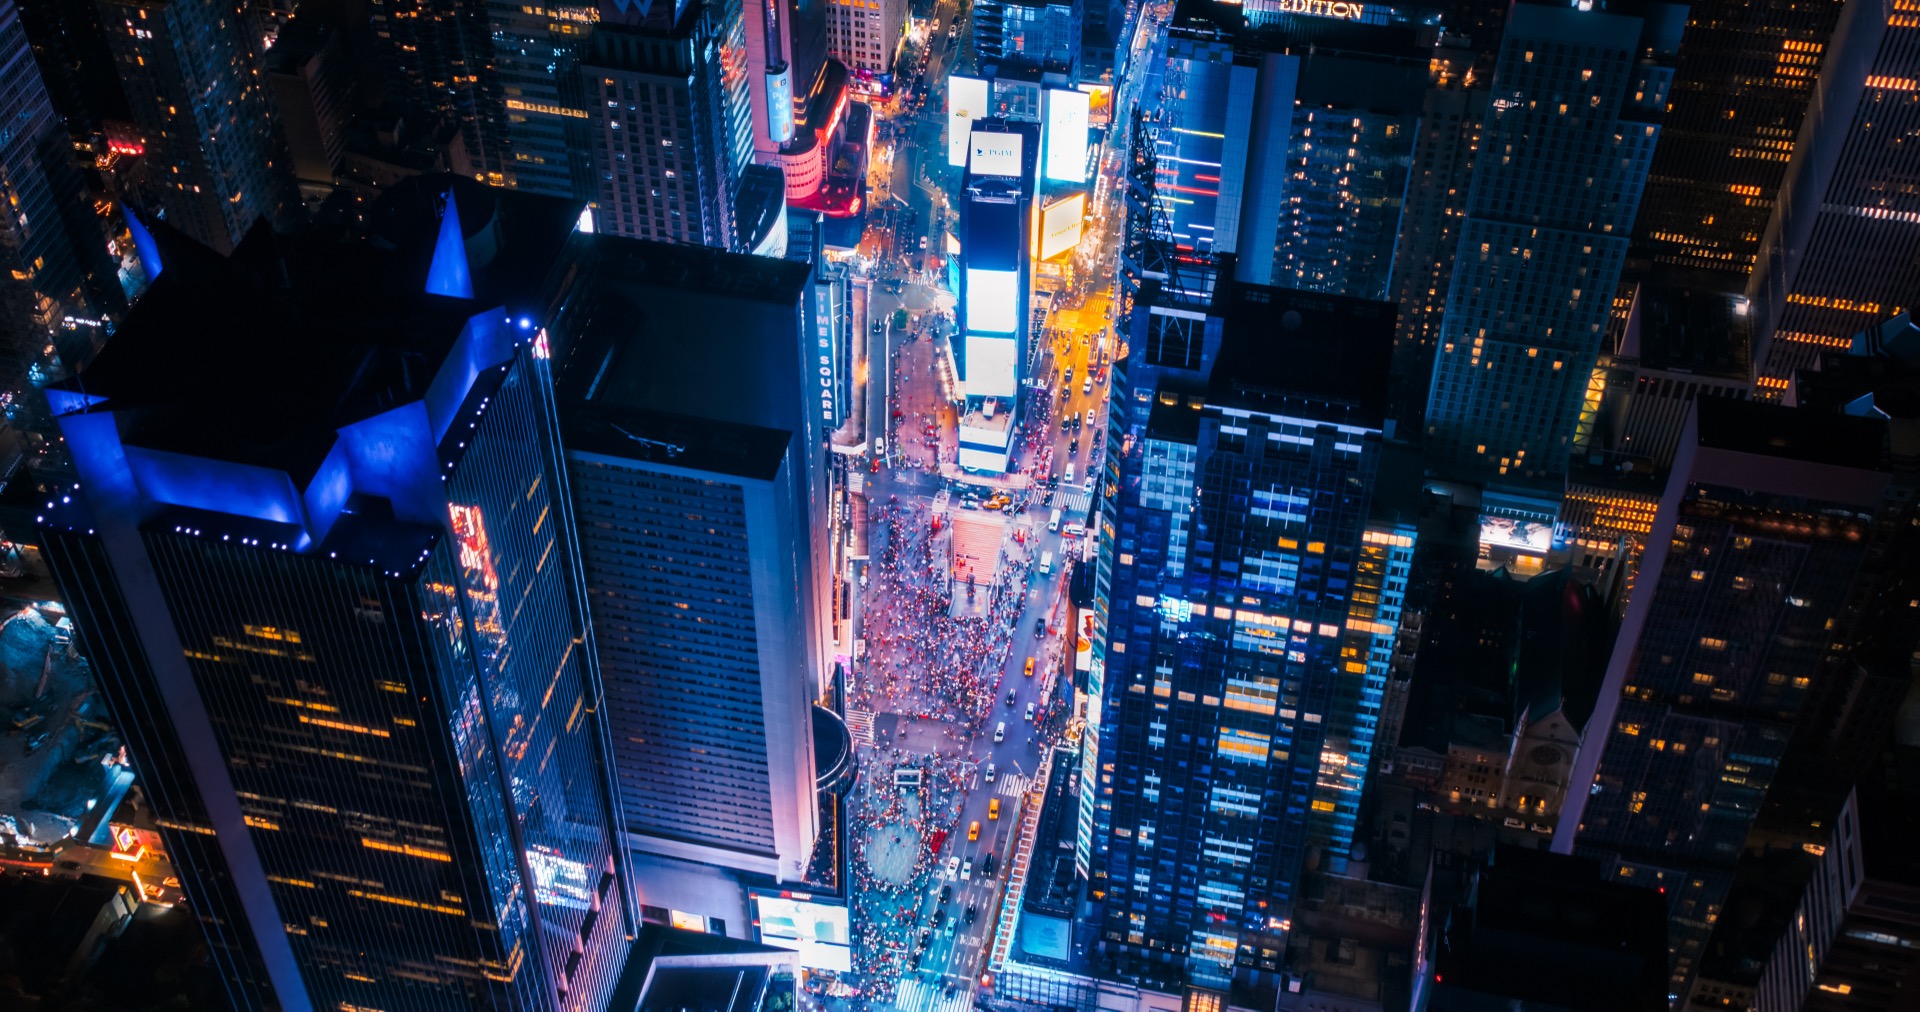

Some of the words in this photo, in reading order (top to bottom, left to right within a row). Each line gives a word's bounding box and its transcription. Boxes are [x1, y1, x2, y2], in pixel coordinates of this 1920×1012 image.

[1279, 0, 1364, 19] EDITION
[816, 292, 829, 348] TIMES
[819, 356, 833, 420] SQUARE
